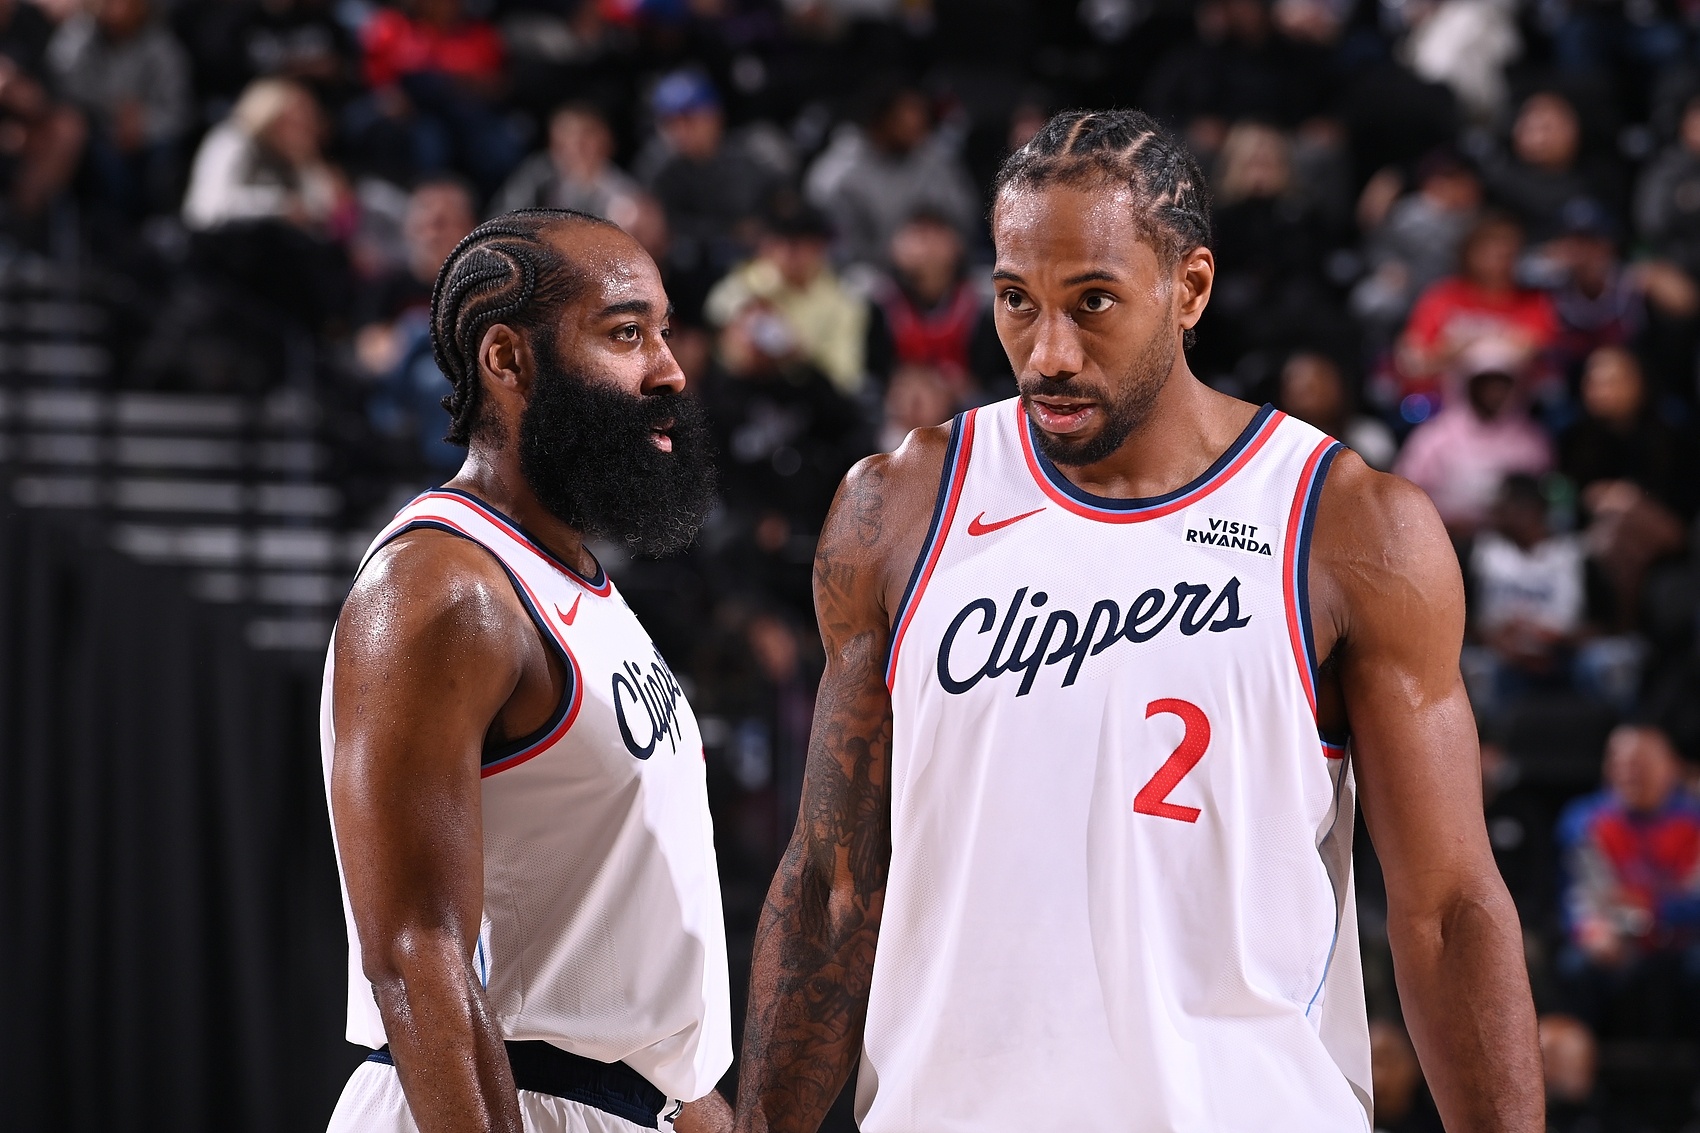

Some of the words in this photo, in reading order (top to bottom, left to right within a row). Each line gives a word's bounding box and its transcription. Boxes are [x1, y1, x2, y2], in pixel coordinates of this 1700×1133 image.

[1186, 529, 1272, 556] RWANDA
[1208, 517, 1258, 538] VISIT
[936, 576, 1253, 697] Clippers
[612, 641, 683, 761] Clipp
[1133, 698, 1211, 824] 2
